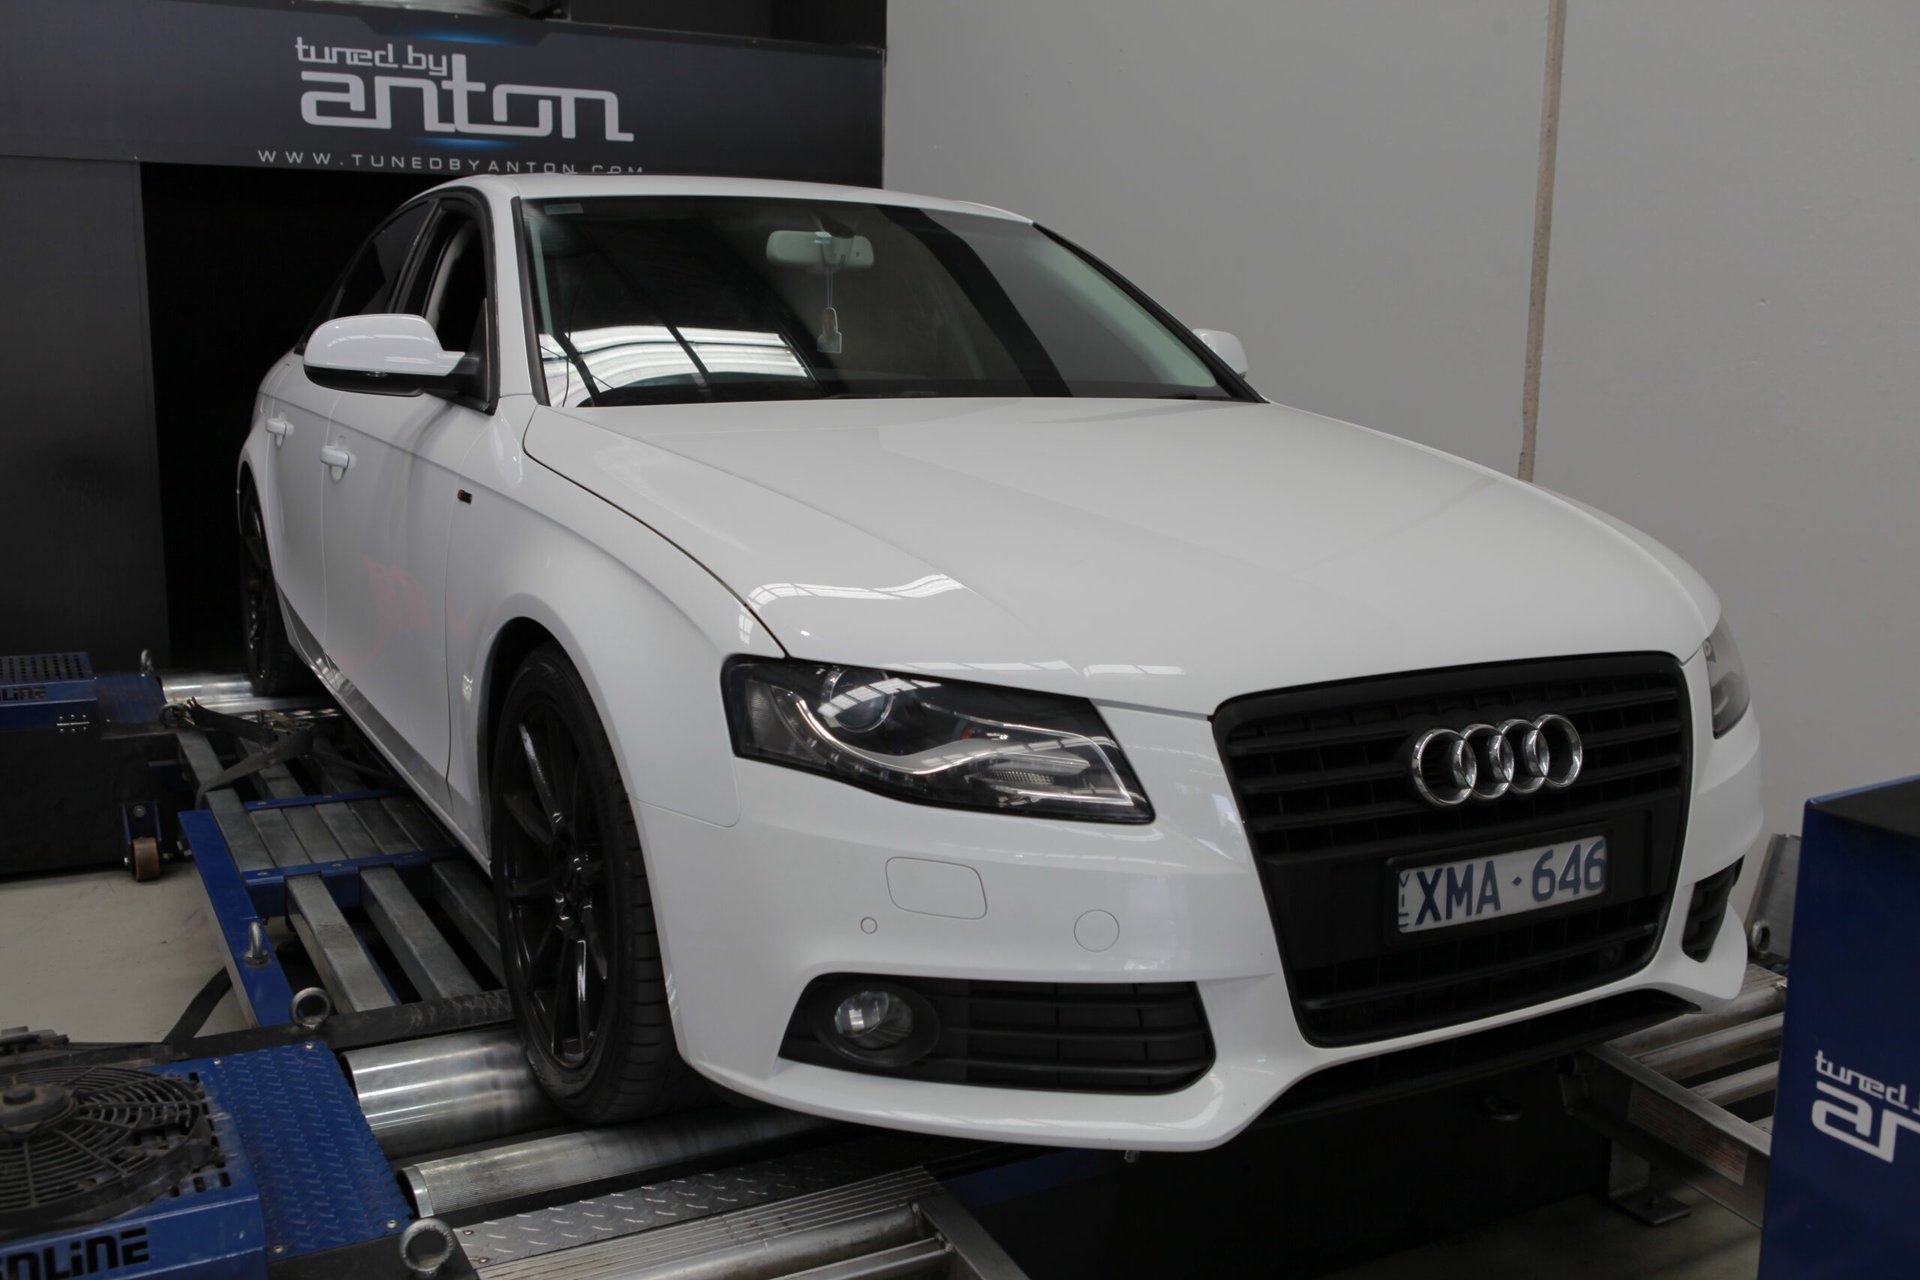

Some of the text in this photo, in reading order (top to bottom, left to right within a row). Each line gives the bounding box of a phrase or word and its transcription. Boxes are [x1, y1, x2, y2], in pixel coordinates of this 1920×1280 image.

[295, 36, 448, 77] tuned by
[300, 53, 635, 142] anton
[257, 149, 643, 175] WWW.TUNEDBYANTONCOM
[1815, 1049, 1909, 1110] tuned
